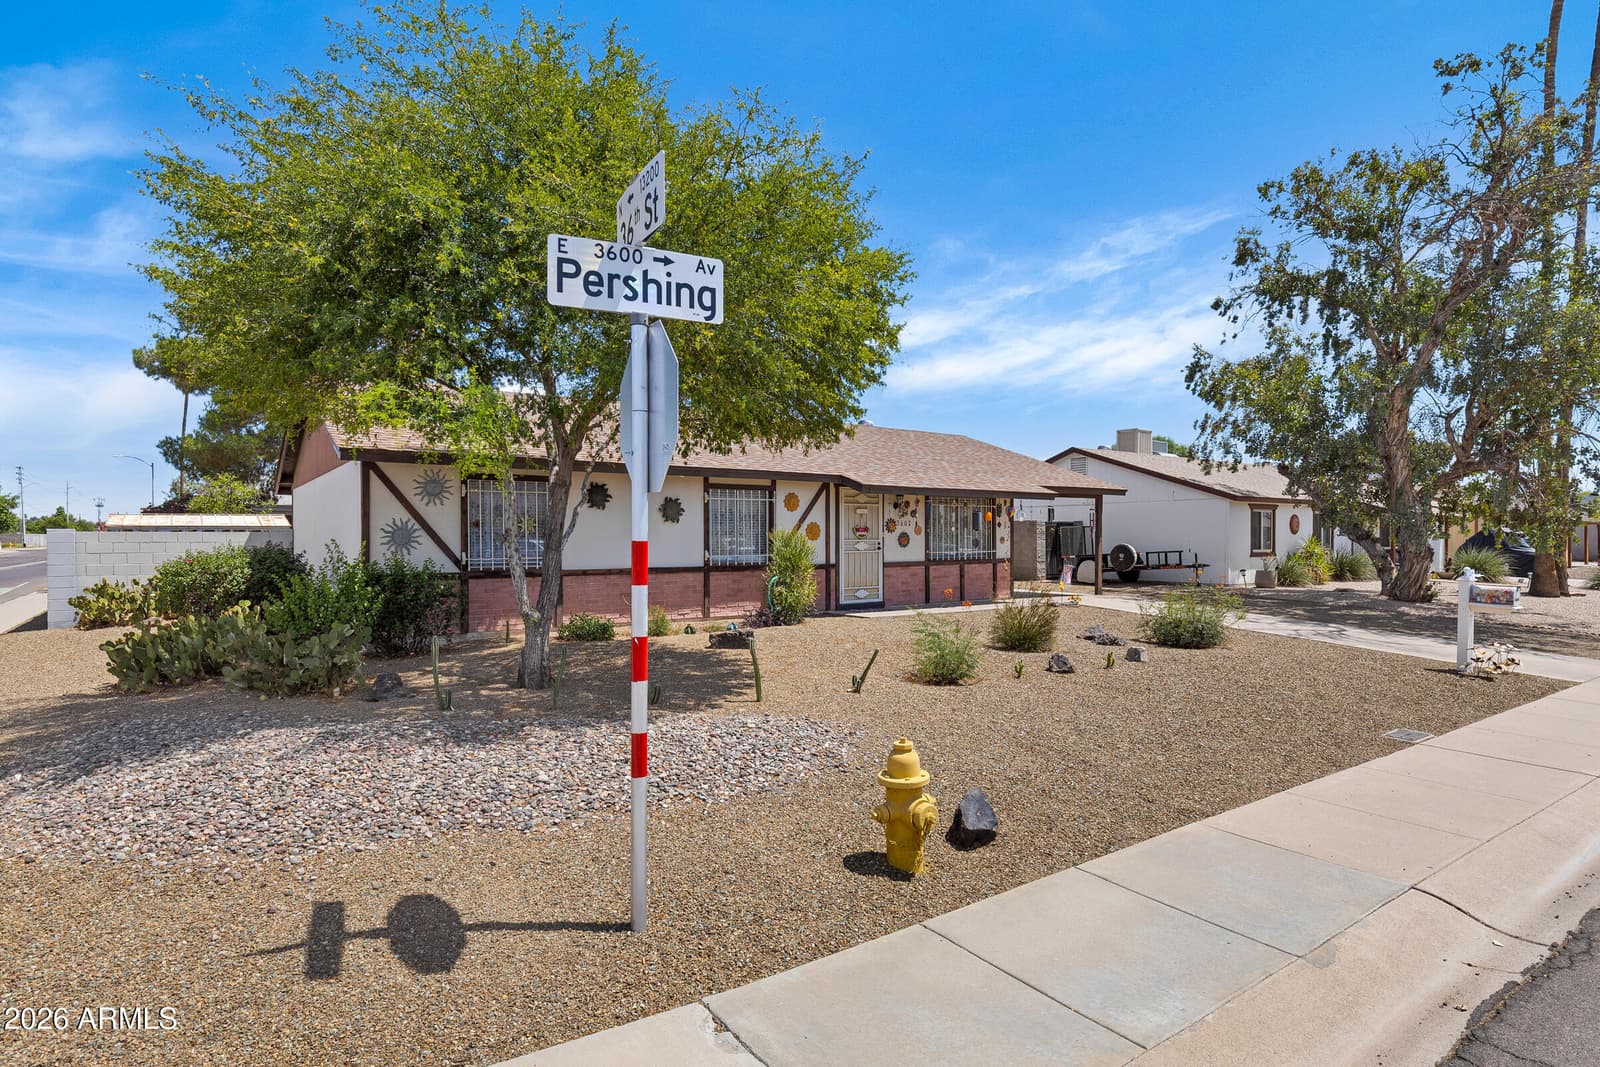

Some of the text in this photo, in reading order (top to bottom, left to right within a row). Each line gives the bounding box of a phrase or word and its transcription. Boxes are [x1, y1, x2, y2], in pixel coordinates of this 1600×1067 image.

[639, 160, 660, 193] 13200
[644, 186, 659, 230] St
[557, 238, 716, 276] E 3600 Av
[556, 256, 717, 322] Pershing
